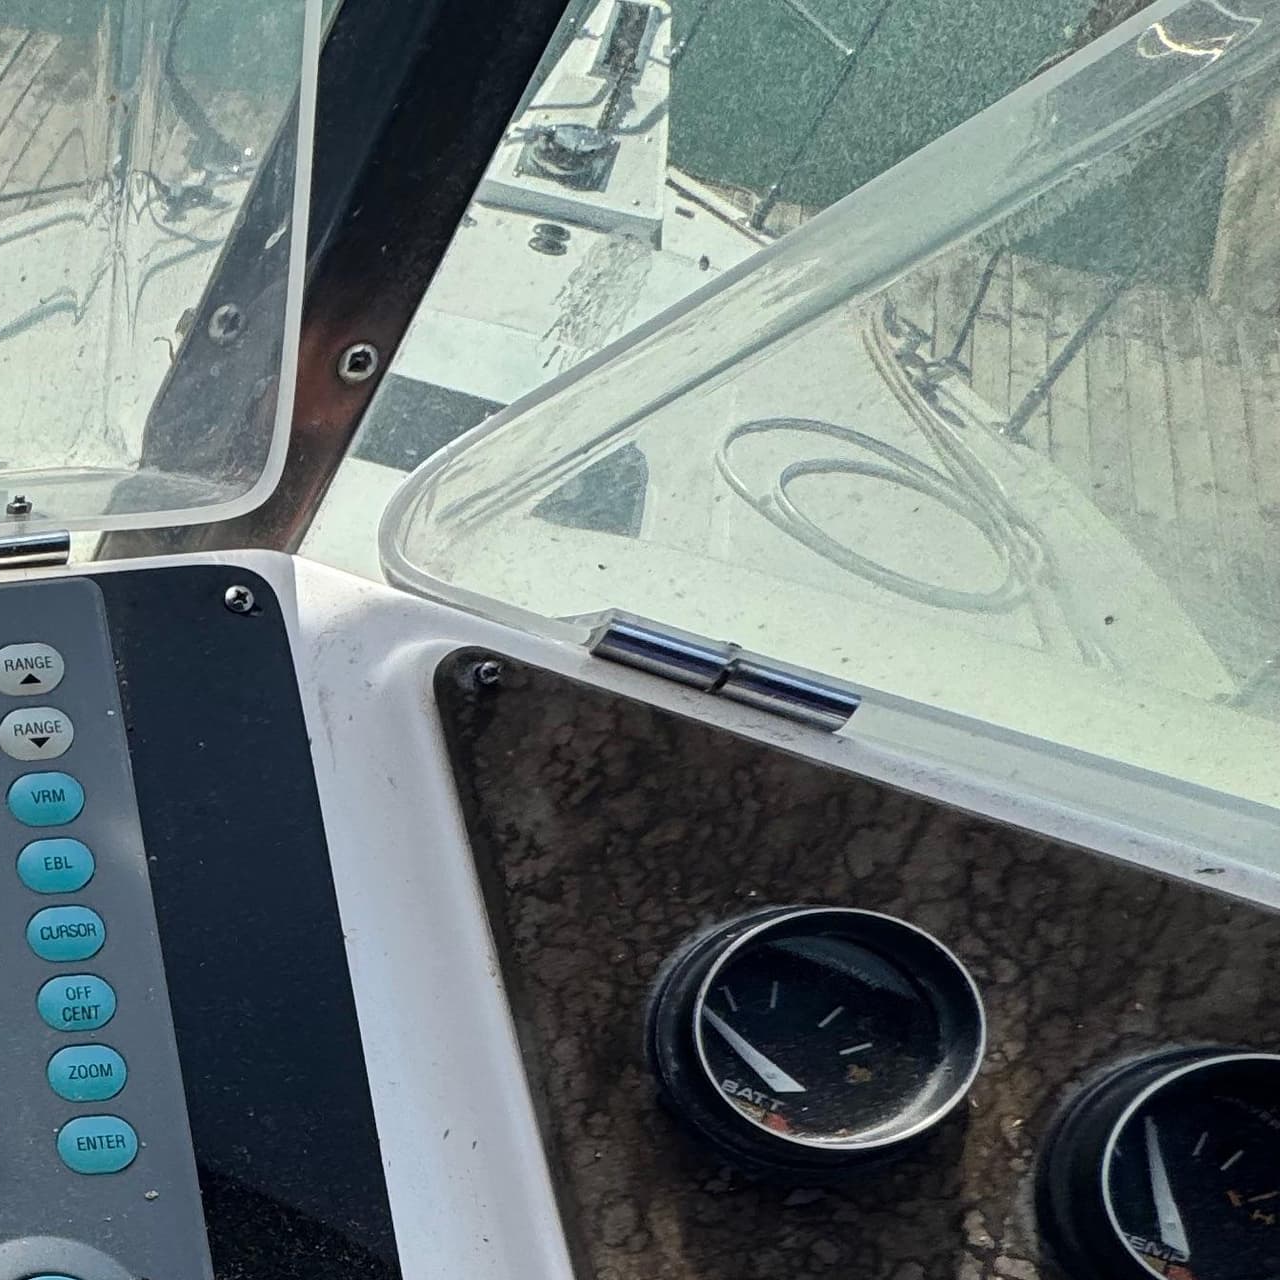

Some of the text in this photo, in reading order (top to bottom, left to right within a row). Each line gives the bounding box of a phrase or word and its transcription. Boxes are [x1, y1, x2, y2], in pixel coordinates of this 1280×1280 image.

[4, 656, 53, 672] RANGE
[13, 720, 63, 736] RANGE
[31, 789, 65, 805] VRM
[44, 856, 73, 871] EBL
[40, 924, 97, 940] CURSOR
[65, 986, 91, 1001] OFF
[62, 1005, 100, 1022] CENT
[68, 1064, 113, 1080] ZOOM
[720, 1079, 785, 1112] BATT
[76, 1134, 126, 1151] ENTER
